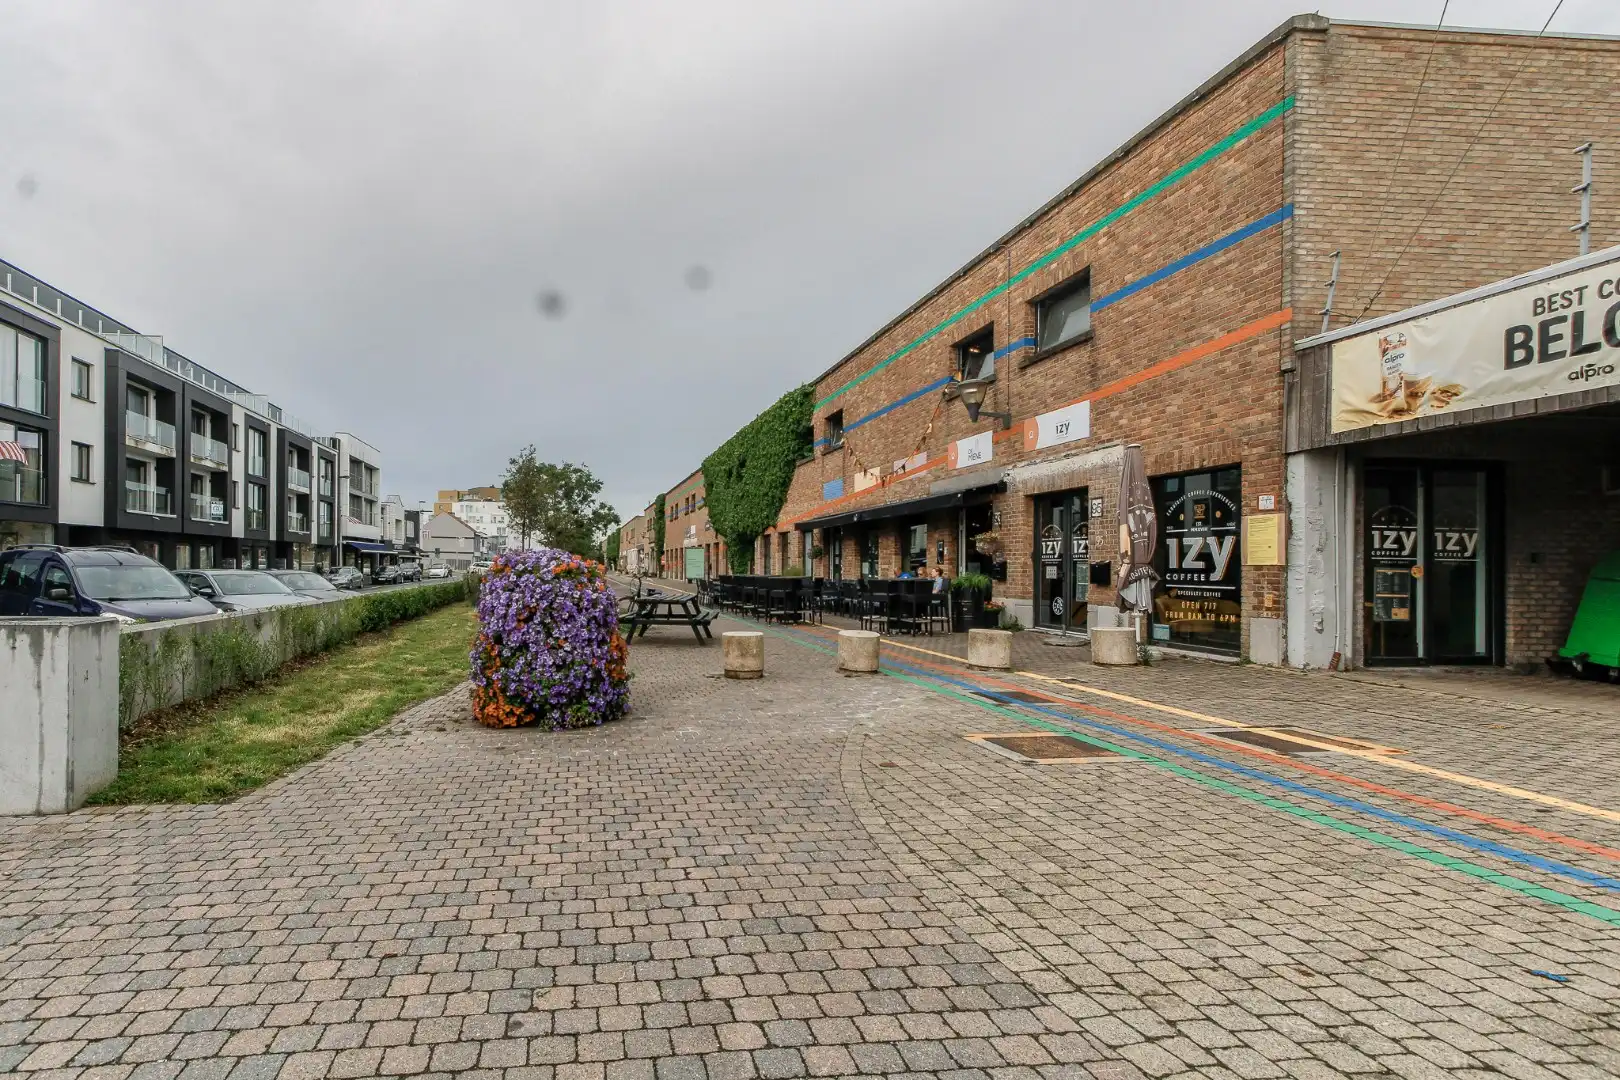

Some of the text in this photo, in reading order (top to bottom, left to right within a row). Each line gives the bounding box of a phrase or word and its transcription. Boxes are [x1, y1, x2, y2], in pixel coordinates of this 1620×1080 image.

[1533, 285, 1588, 317] BEST
[1568, 363, 1614, 381] alpro
[1166, 573, 1205, 581] COFFEE
[1181, 601, 1200, 609] OPEN
[1165, 611, 1184, 619] FROM
